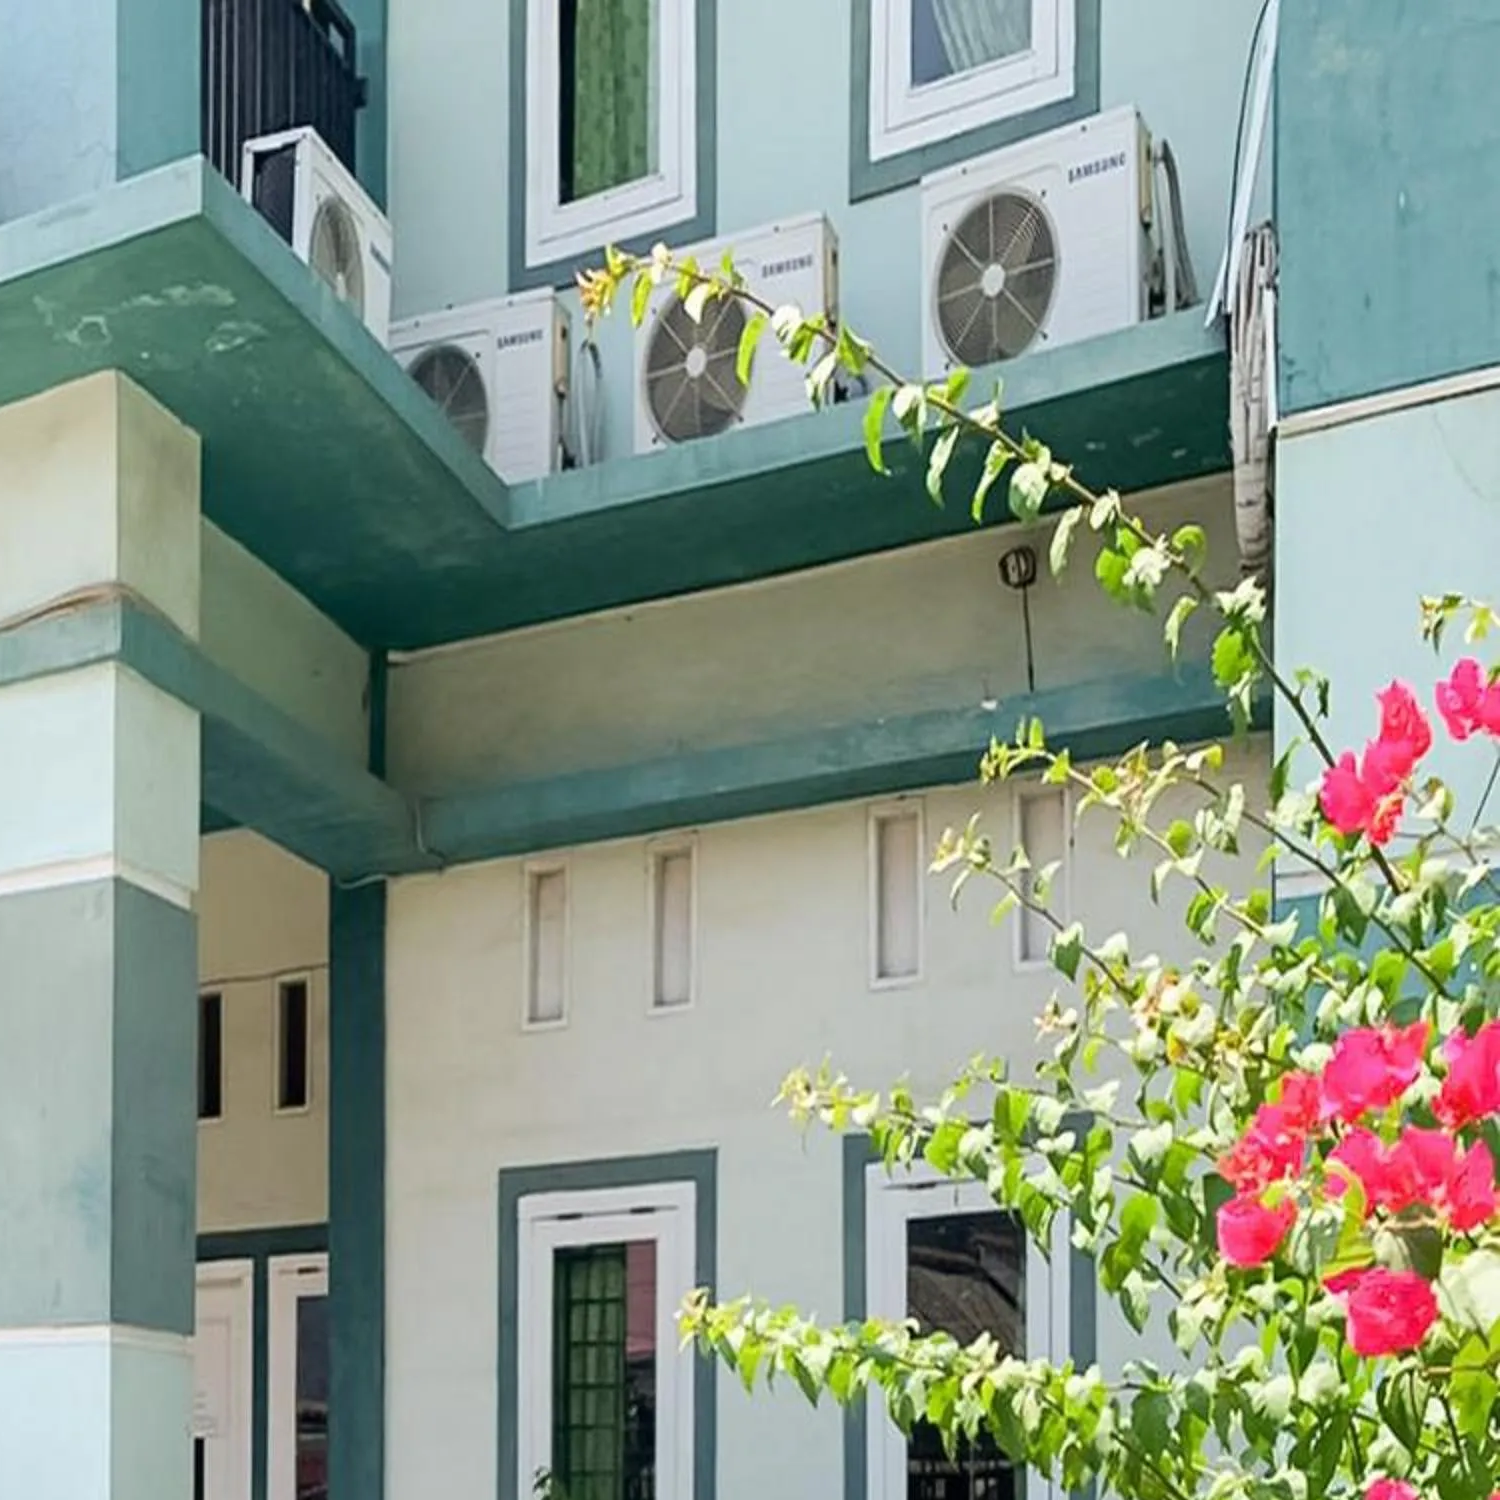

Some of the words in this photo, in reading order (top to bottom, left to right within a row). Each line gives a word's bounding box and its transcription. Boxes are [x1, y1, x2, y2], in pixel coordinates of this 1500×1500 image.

[1068, 151, 1127, 184] SAMSUNG
[761, 254, 814, 279] SAMSUNG
[496, 328, 544, 350] SAMSUNG
